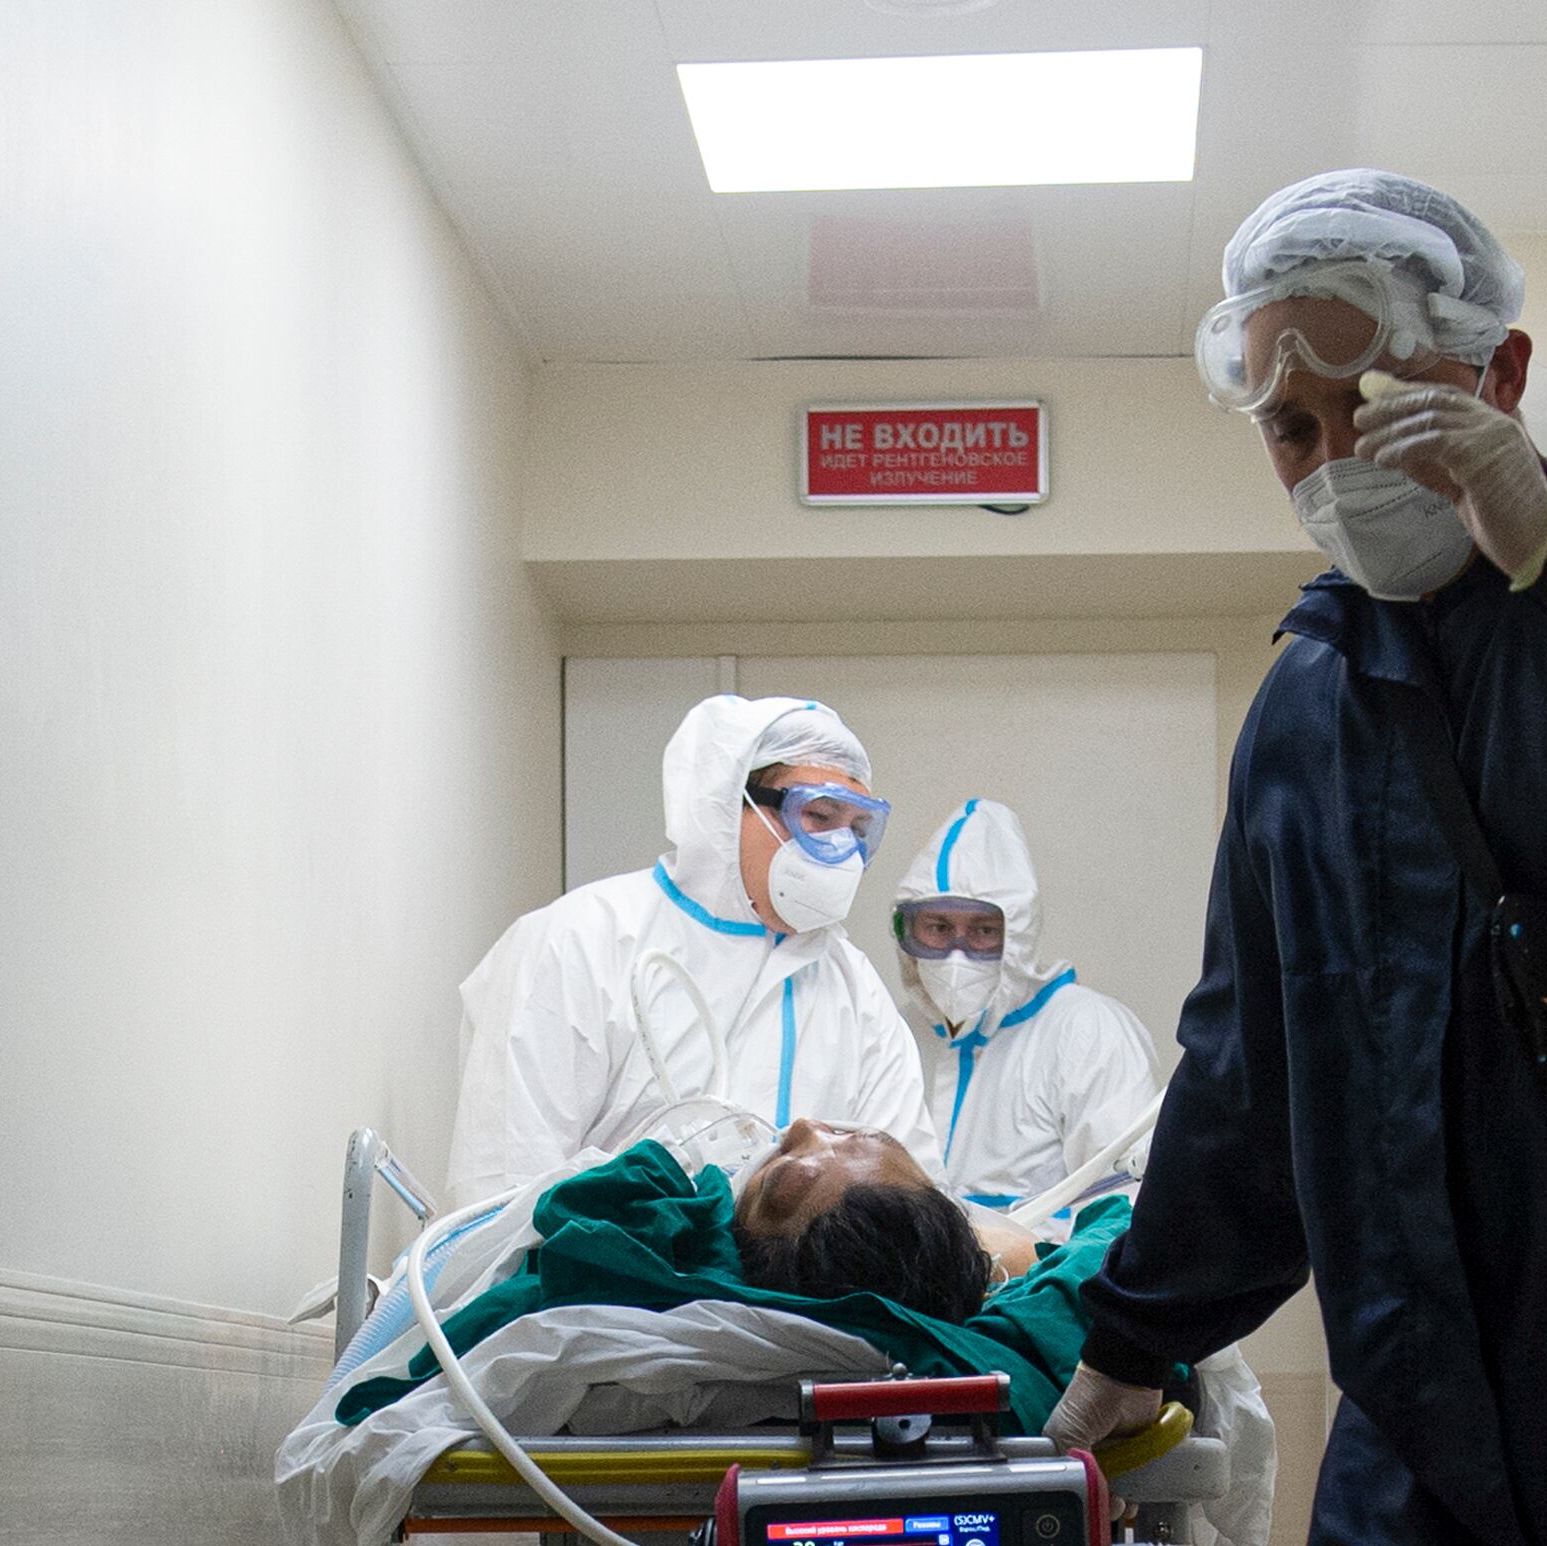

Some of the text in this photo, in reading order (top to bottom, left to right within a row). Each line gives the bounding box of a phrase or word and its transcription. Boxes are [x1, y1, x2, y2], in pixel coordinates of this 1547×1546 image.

[820, 421, 1030, 453] НЕ ВХОДИТЬ
[820, 451, 1028, 469] ИДЕТ РЕНТГЕНОВСКОЕ
[870, 470, 979, 486] ИЗЛУЧЕНИЕ
[954, 1514, 995, 1526] (S)CMV+
